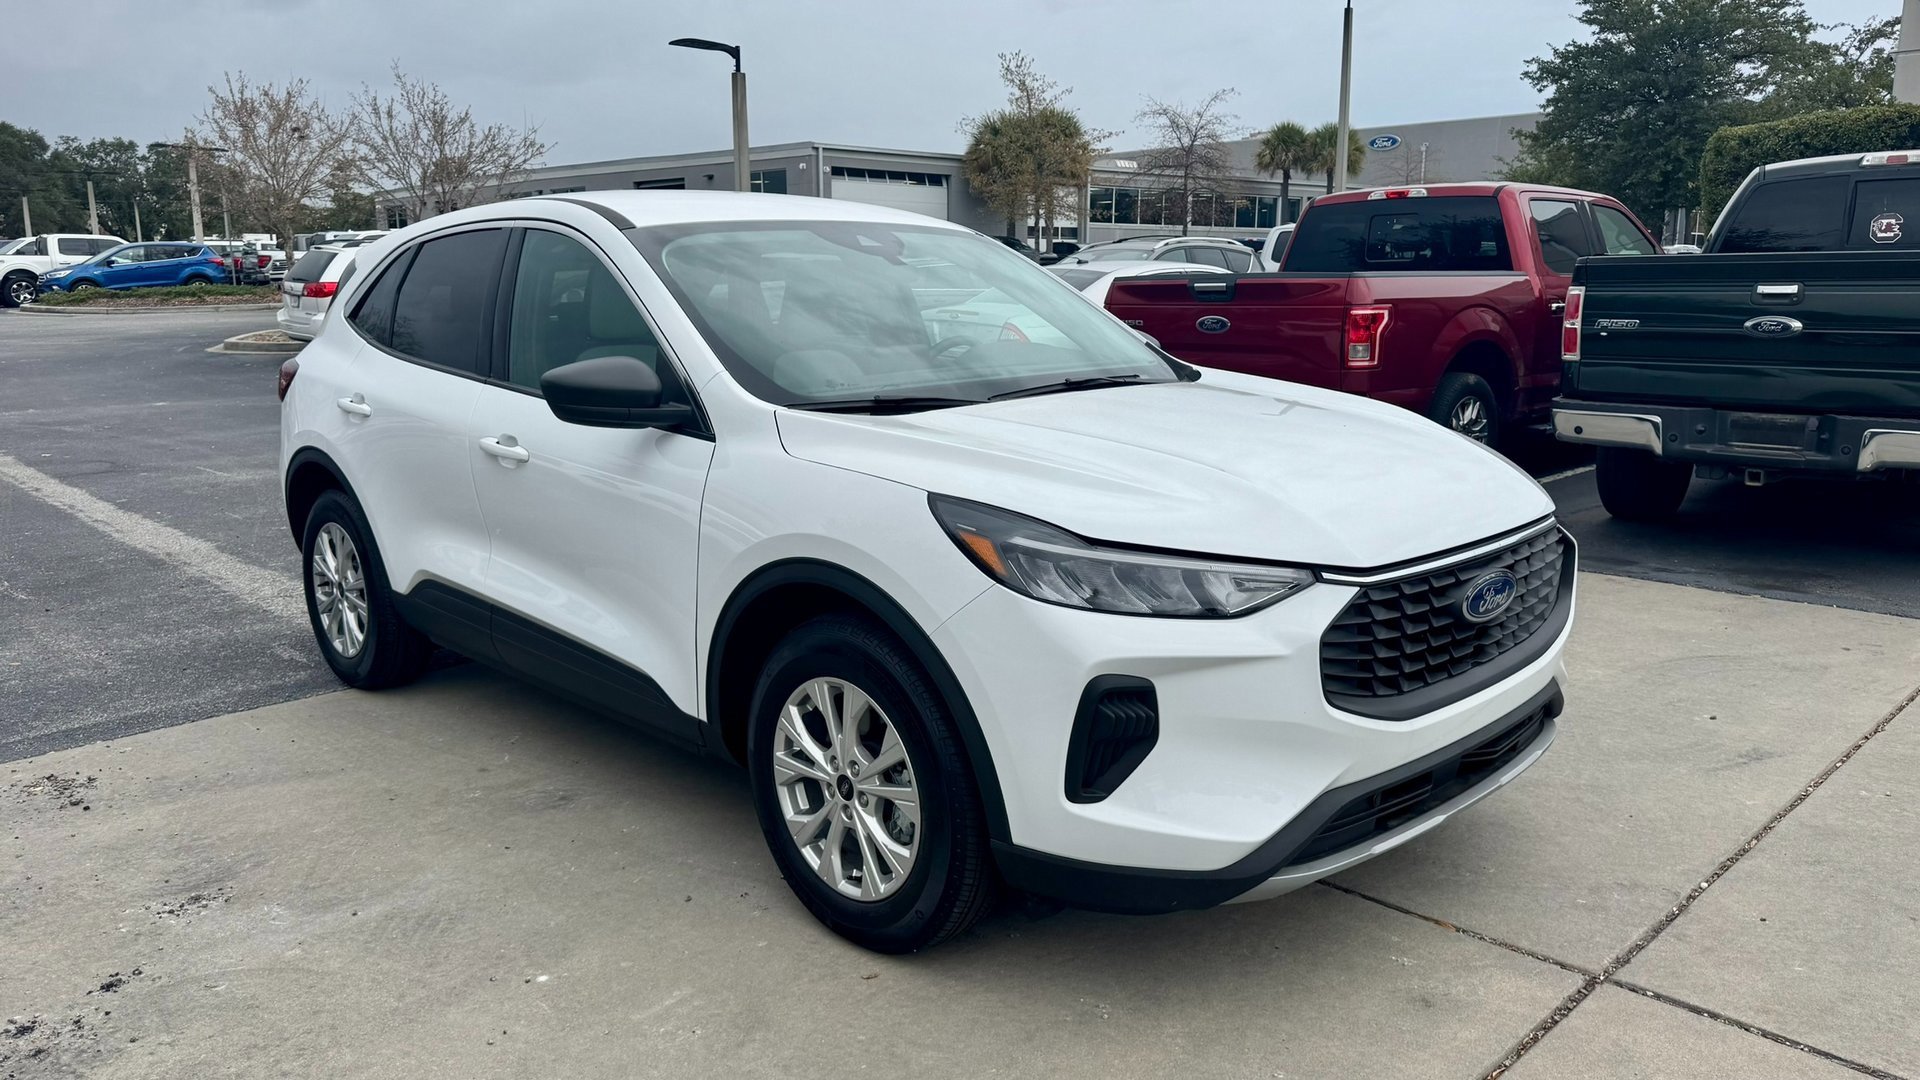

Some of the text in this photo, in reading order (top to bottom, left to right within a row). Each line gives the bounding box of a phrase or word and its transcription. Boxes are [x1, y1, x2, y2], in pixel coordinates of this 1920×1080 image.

[1374, 138, 1393, 148] Ford
[1203, 319, 1222, 329] Ford
[1757, 321, 1784, 331] Ford
[1479, 582, 1510, 613] Ford
